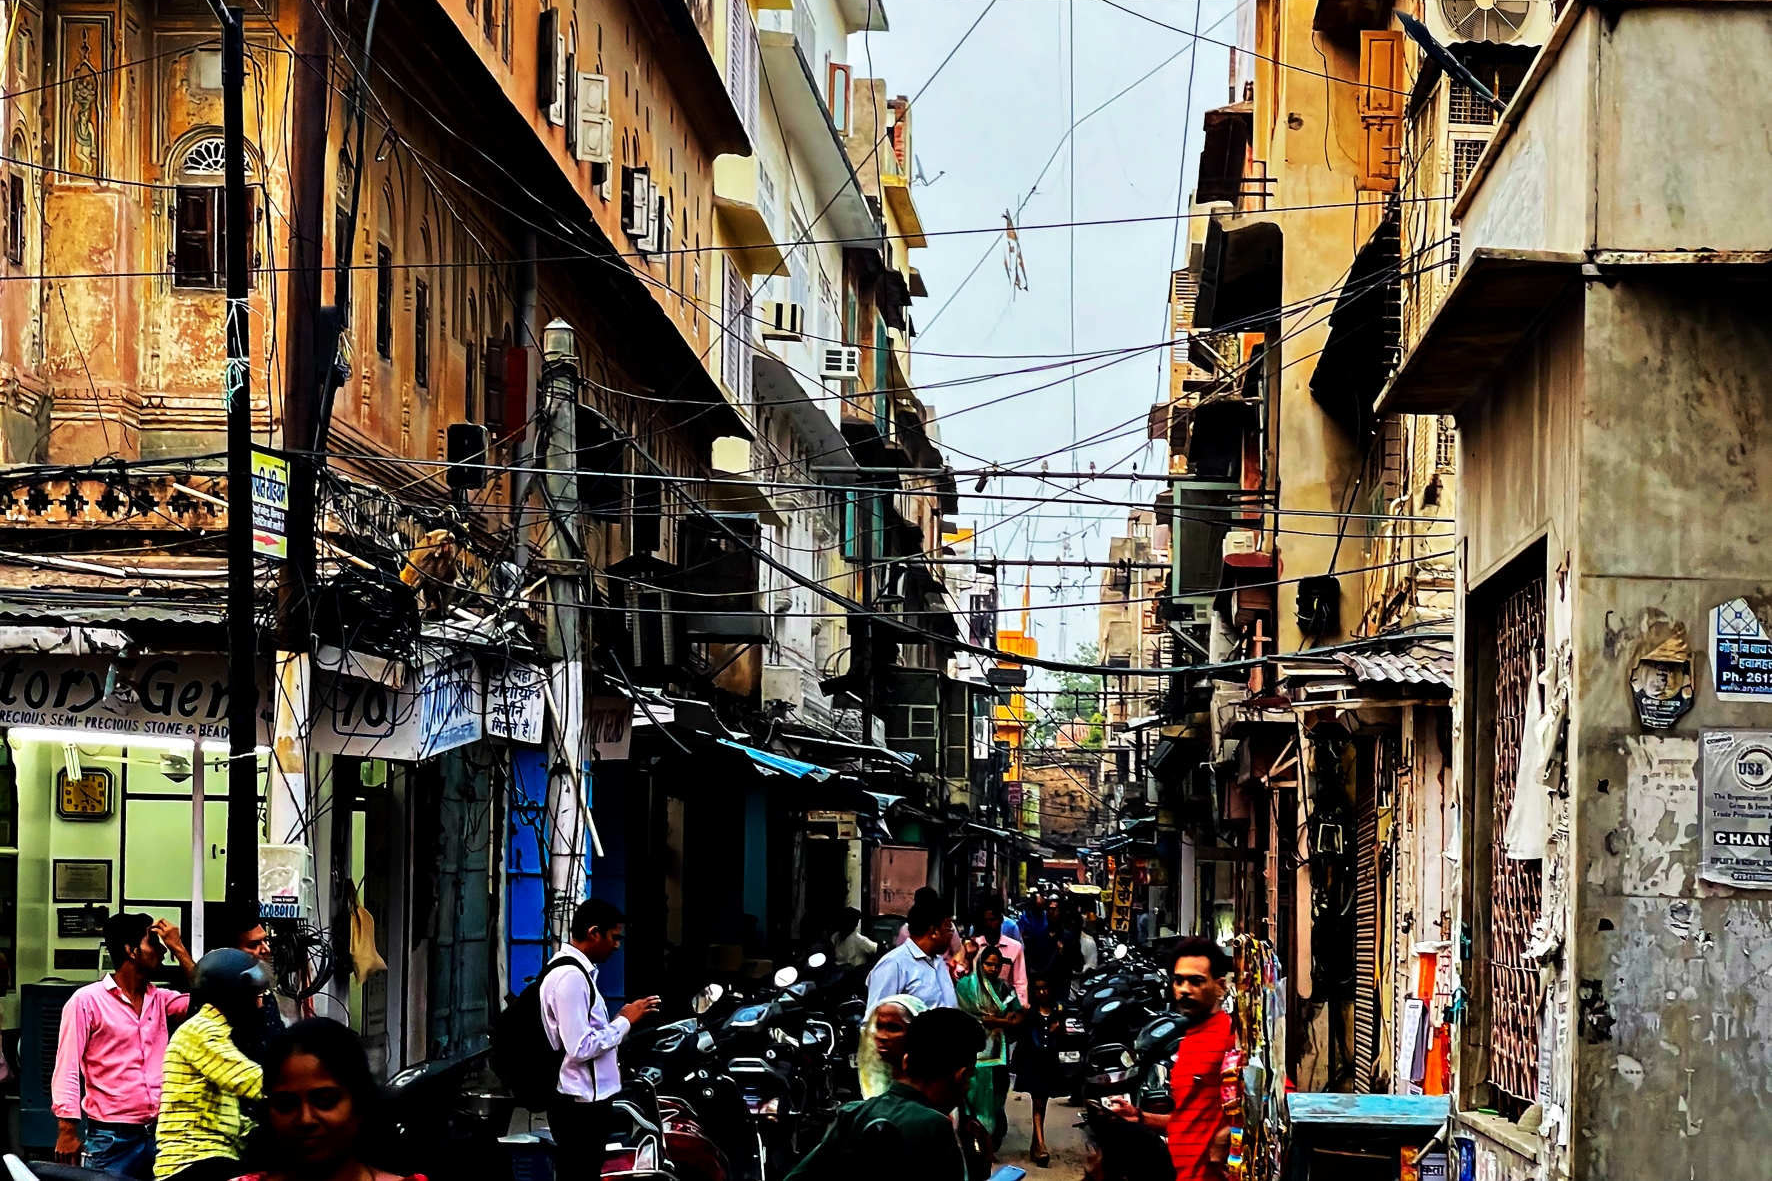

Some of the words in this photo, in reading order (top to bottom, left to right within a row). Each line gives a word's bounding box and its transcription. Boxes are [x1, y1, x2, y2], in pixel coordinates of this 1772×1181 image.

[1722, 671, 1743, 682] Ph.
[0, 655, 104, 713] tory
[341, 681, 388, 728] 70
[143, 721, 182, 735] STONE
[186, 724, 196, 735] &
[1738, 762, 1764, 776] USA
[1715, 832, 1770, 846] CHAN
